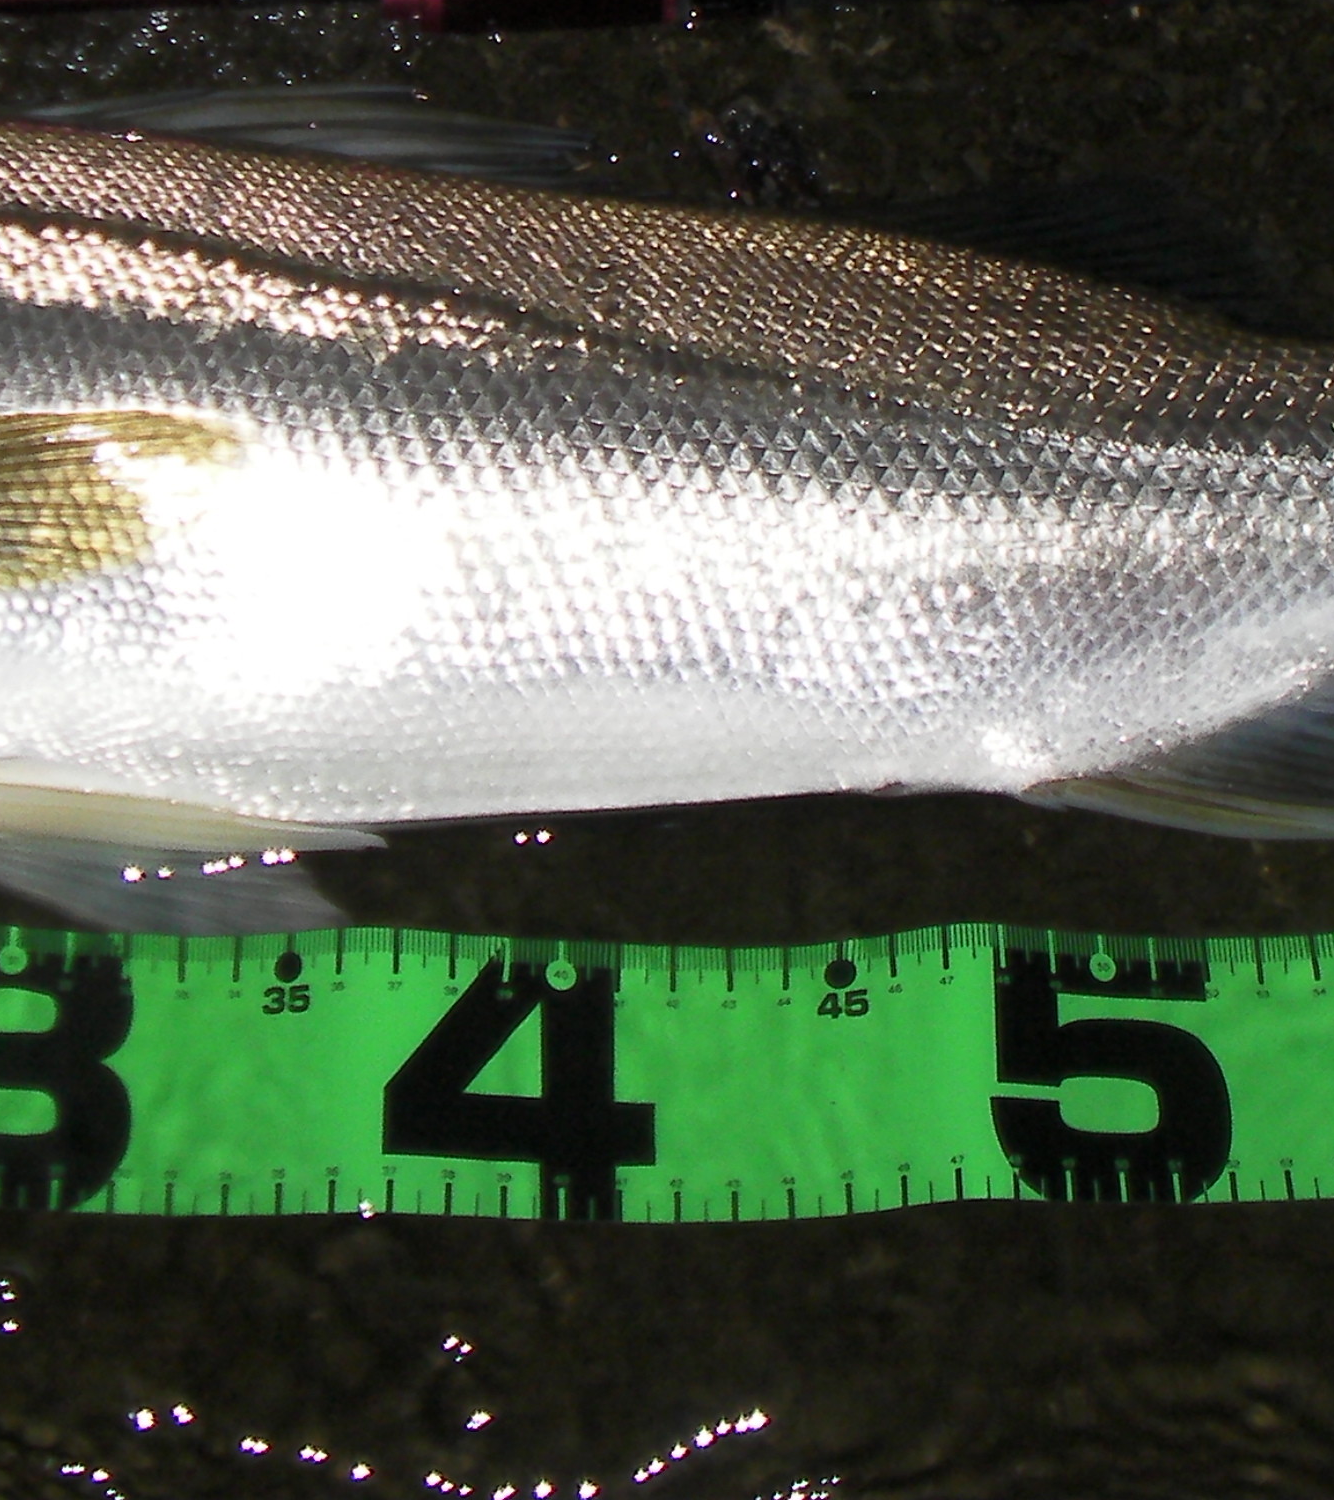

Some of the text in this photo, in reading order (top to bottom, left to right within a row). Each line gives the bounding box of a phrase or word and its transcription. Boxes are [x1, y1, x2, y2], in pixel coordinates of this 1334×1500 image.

[387, 981, 402, 991] 37
[939, 975, 954, 986] 47
[262, 984, 311, 1015] 35
[817, 988, 870, 1019] 45
[383, 940, 656, 1220] 4
[990, 927, 1232, 1203] 5
[950, 1154, 965, 1165] 47
